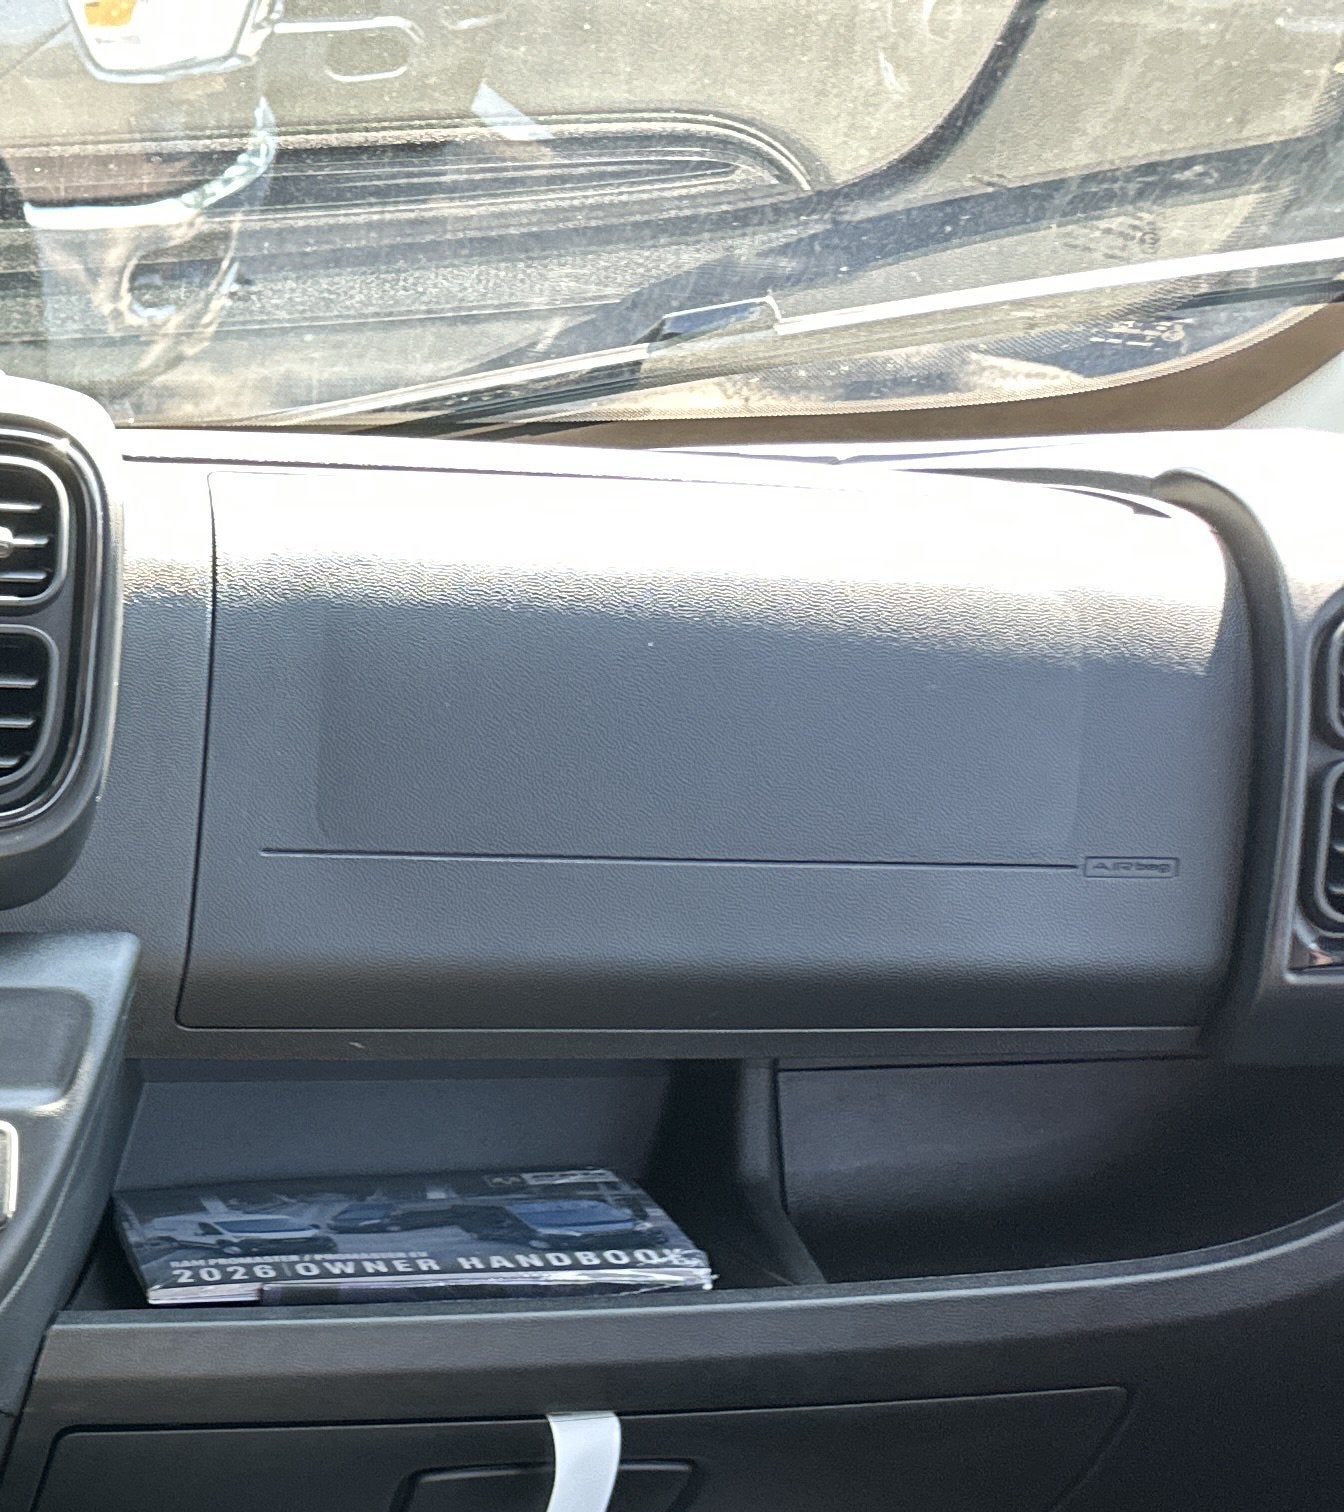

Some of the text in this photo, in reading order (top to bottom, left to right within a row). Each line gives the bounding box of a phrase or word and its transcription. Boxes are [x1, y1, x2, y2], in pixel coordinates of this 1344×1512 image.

[170, 1259, 208, 1268] RAM
[172, 1249, 684, 1283] 2026 OWNER HANDBOOK
